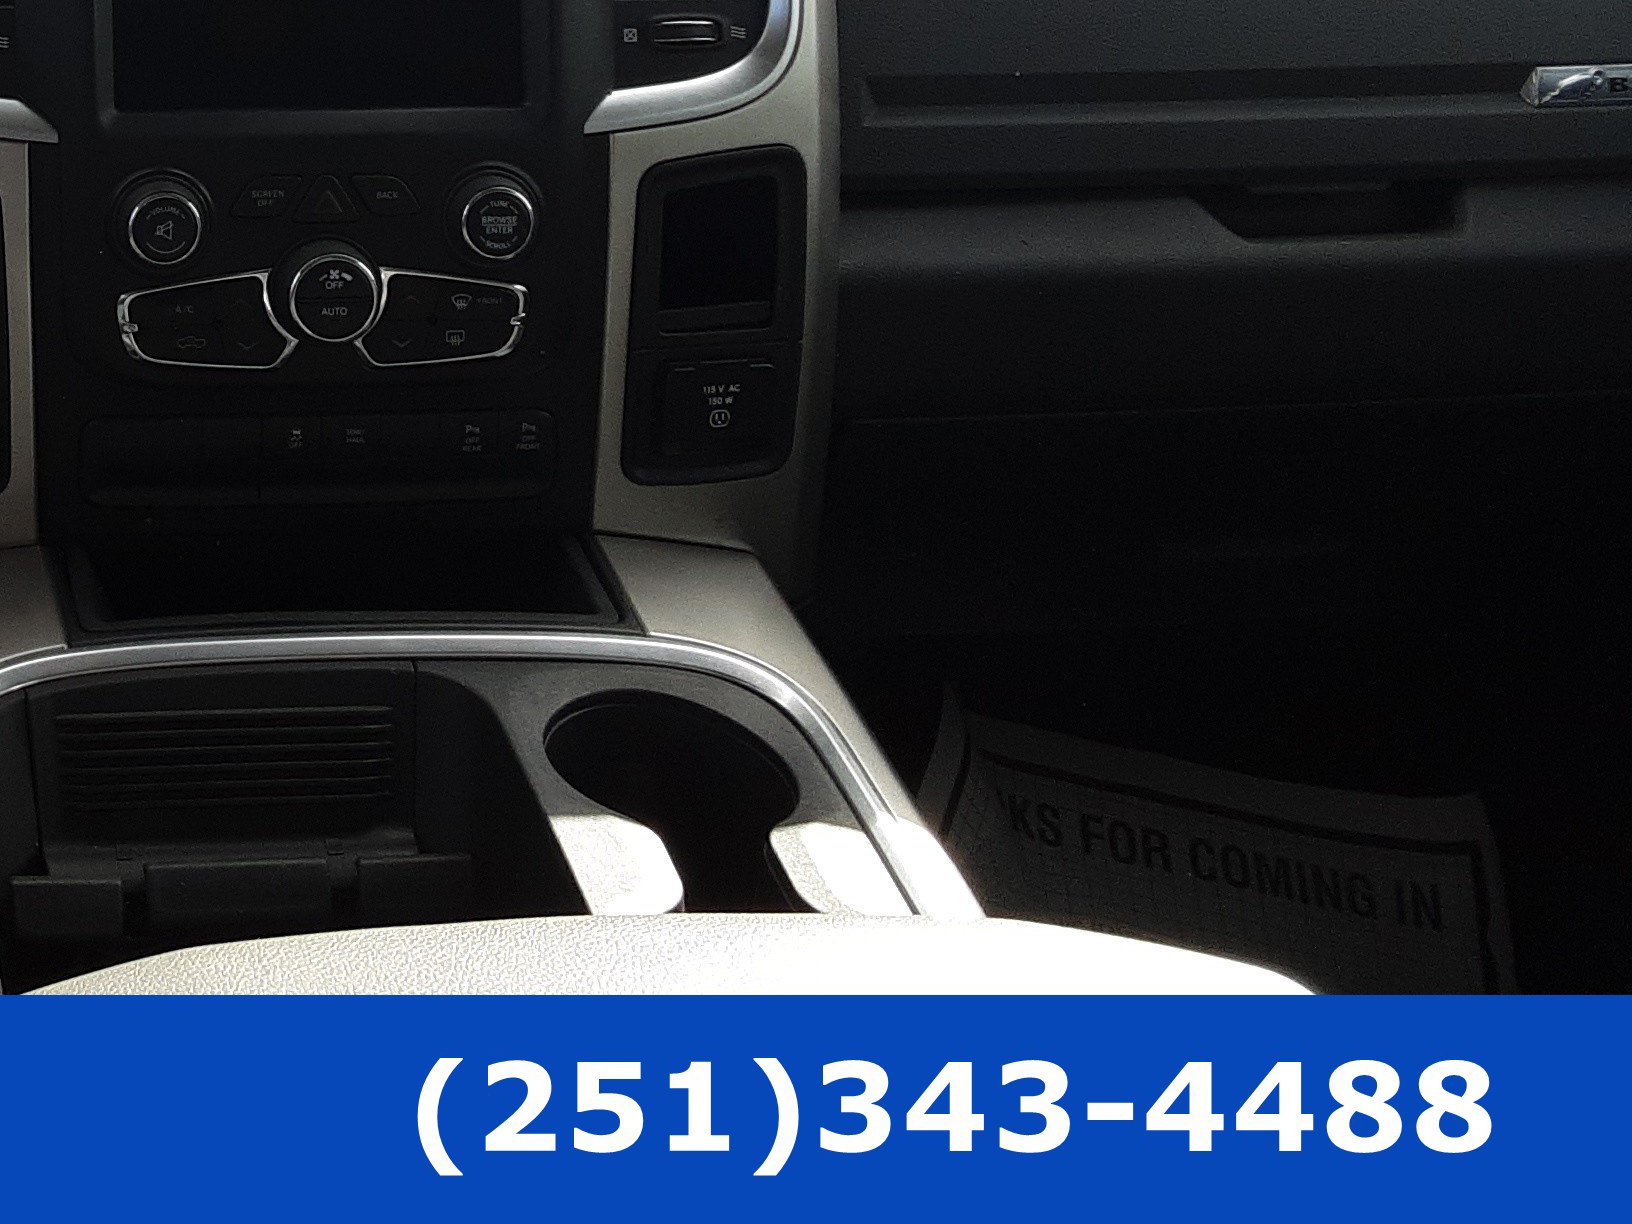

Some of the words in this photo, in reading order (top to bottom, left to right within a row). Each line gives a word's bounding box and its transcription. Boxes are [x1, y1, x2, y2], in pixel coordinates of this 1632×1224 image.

[376, 190, 399, 199] BACK
[481, 215, 518, 225] BROWSE
[485, 225, 514, 234] ENTER
[324, 280, 344, 290] OFF
[320, 306, 349, 316] AUTO
[1080, 812, 1174, 875] FOR
[1187, 837, 1379, 921] COMING
[1394, 879, 1442, 932] IN
